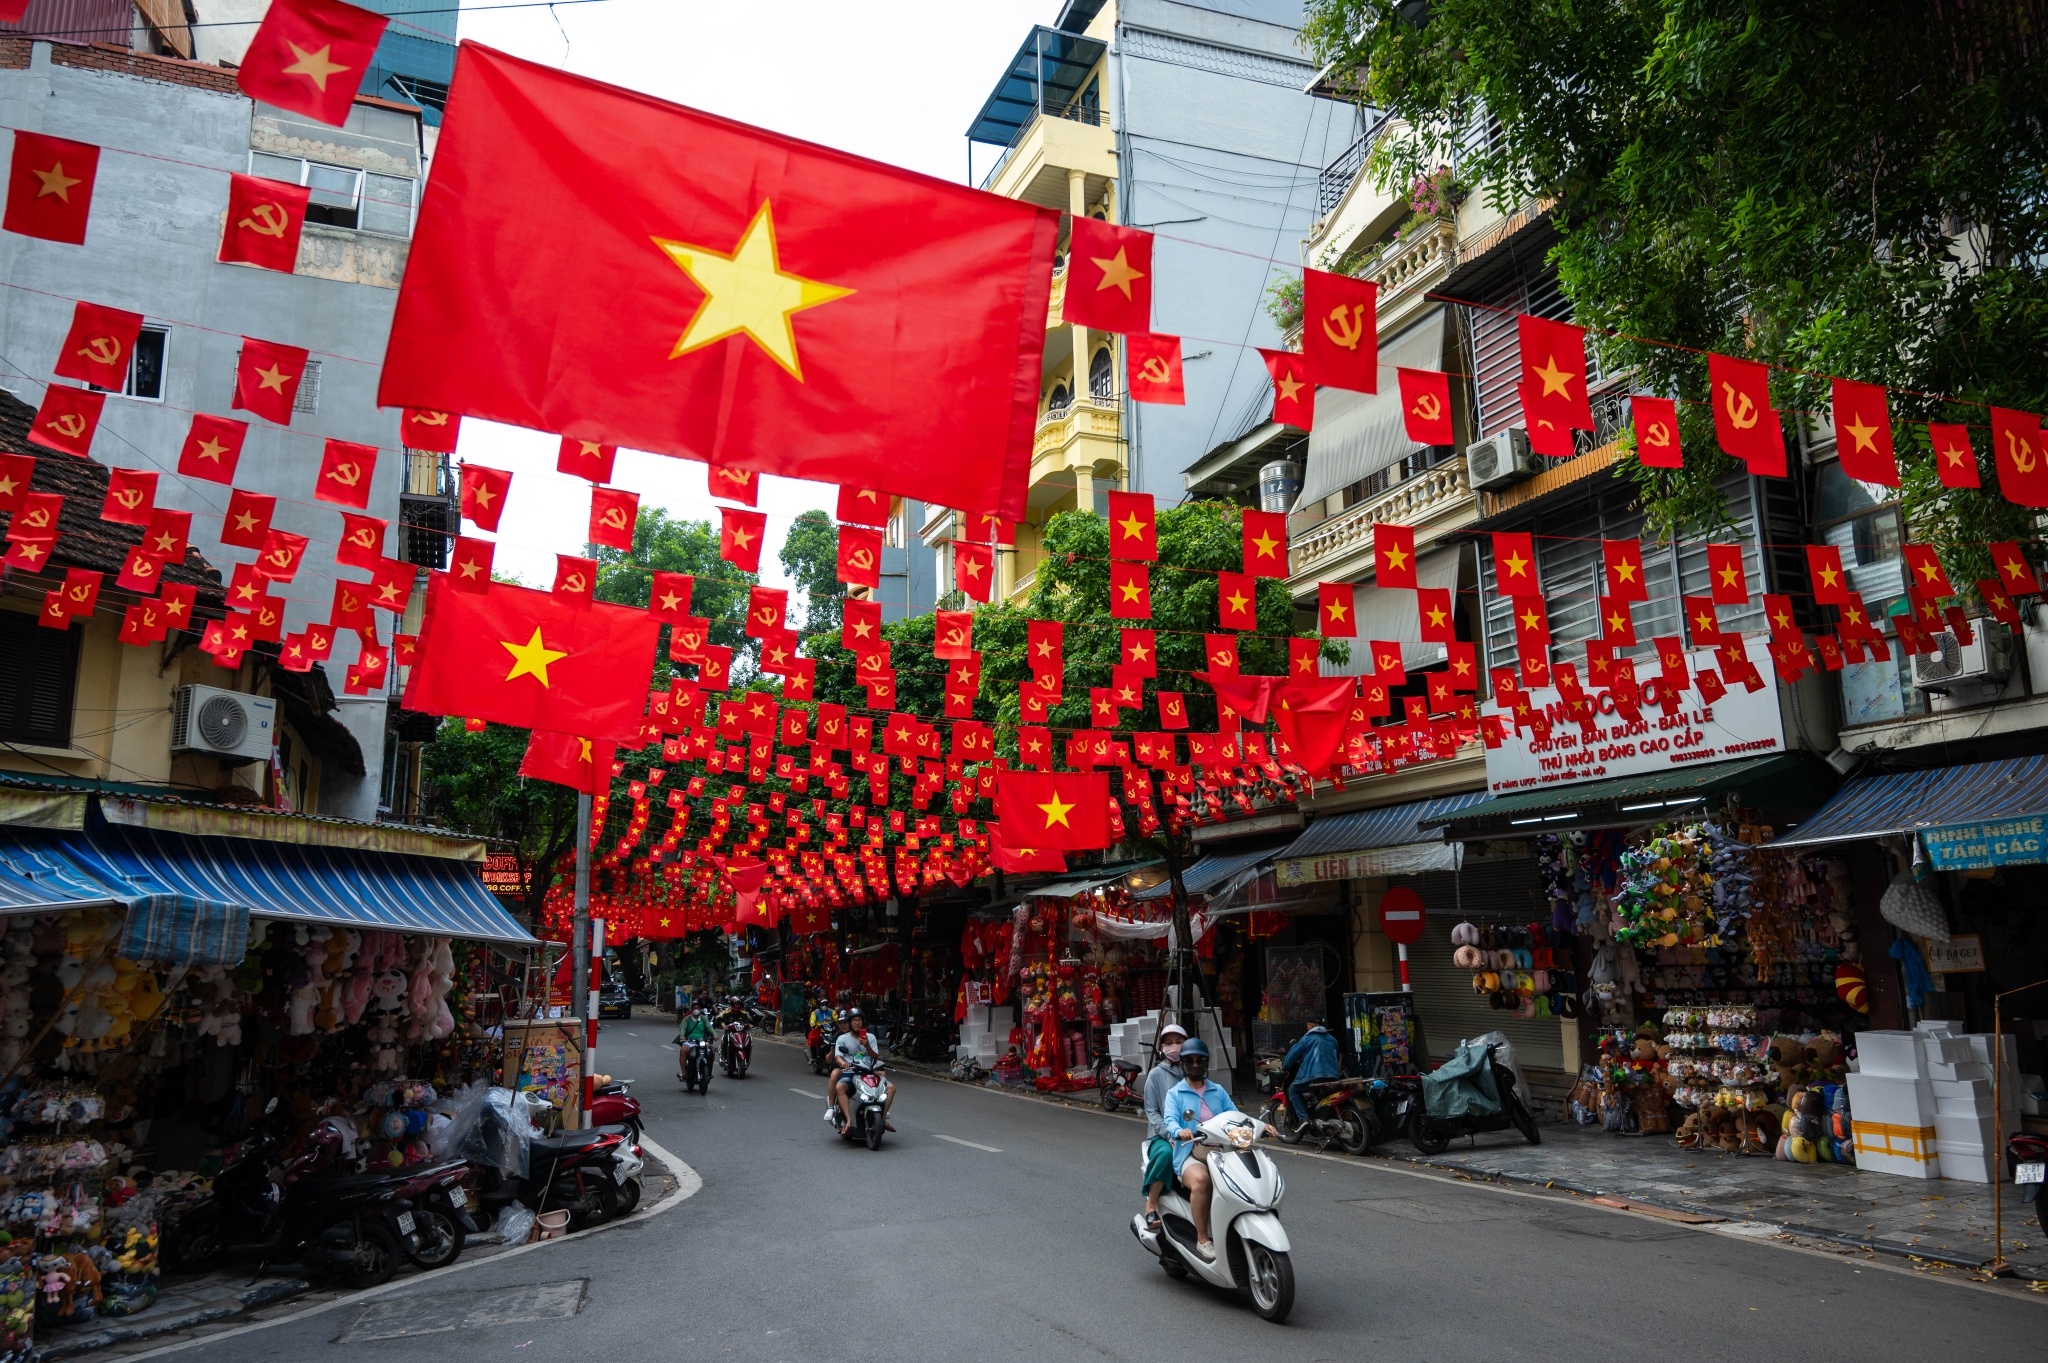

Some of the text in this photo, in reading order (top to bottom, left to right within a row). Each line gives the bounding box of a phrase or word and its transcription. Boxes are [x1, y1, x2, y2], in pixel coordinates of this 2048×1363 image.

[1539, 753, 1562, 771] THÚ
[1598, 744, 1636, 762] BÔNG
[1639, 737, 1668, 755] CAO
[1673, 726, 1704, 748] CẤP
[1994, 838, 2040, 856] CÁC
[482, 871, 532, 884] WORKSHP
[1314, 855, 1349, 880] LIÊN
